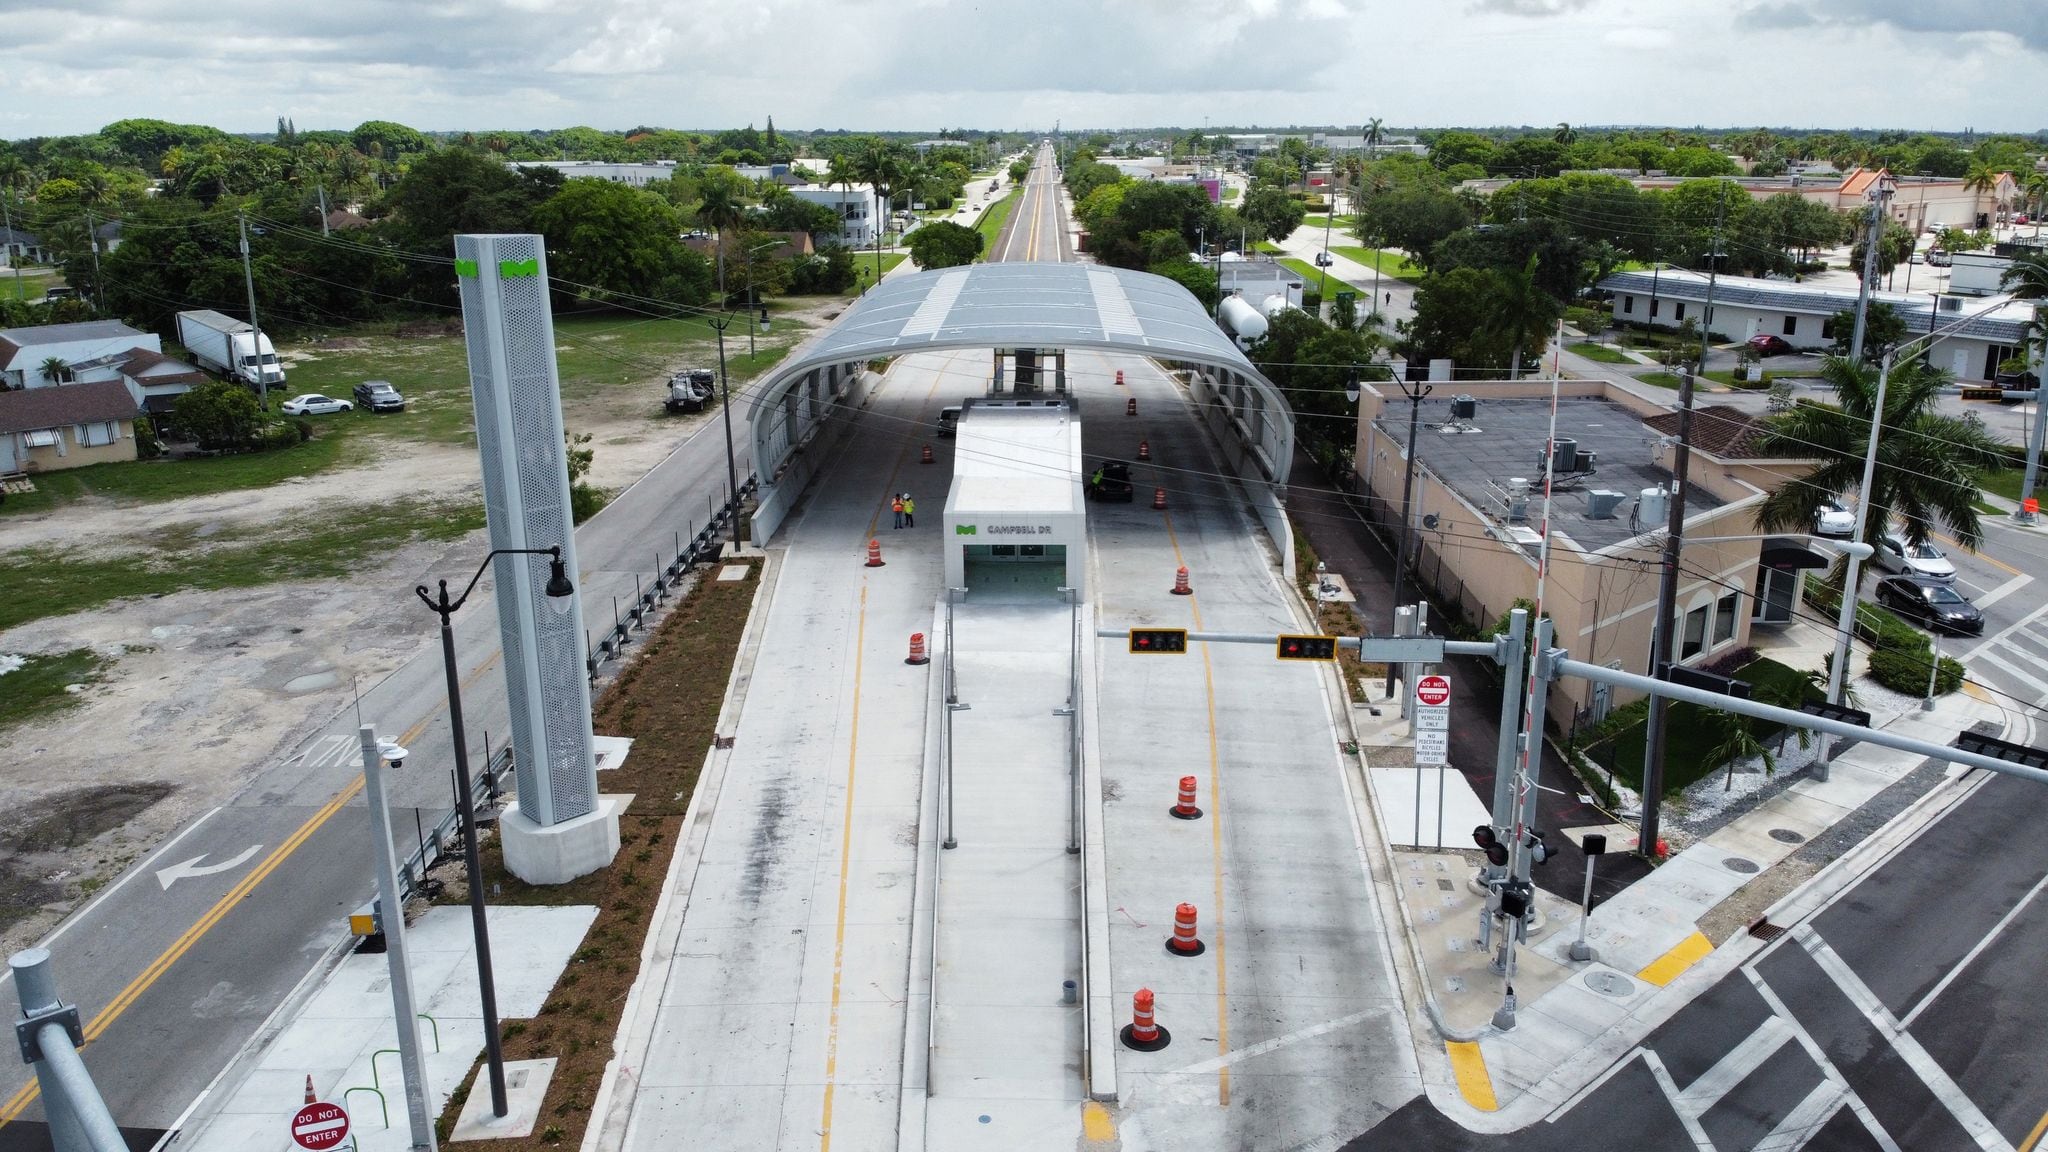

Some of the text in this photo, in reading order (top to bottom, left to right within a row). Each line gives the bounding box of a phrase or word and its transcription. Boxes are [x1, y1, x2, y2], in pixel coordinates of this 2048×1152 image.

[987, 525, 1052, 534] CAMPBELL DR
[298, 1108, 339, 1124] DO NOT
[305, 1130, 338, 1144] ENTER
